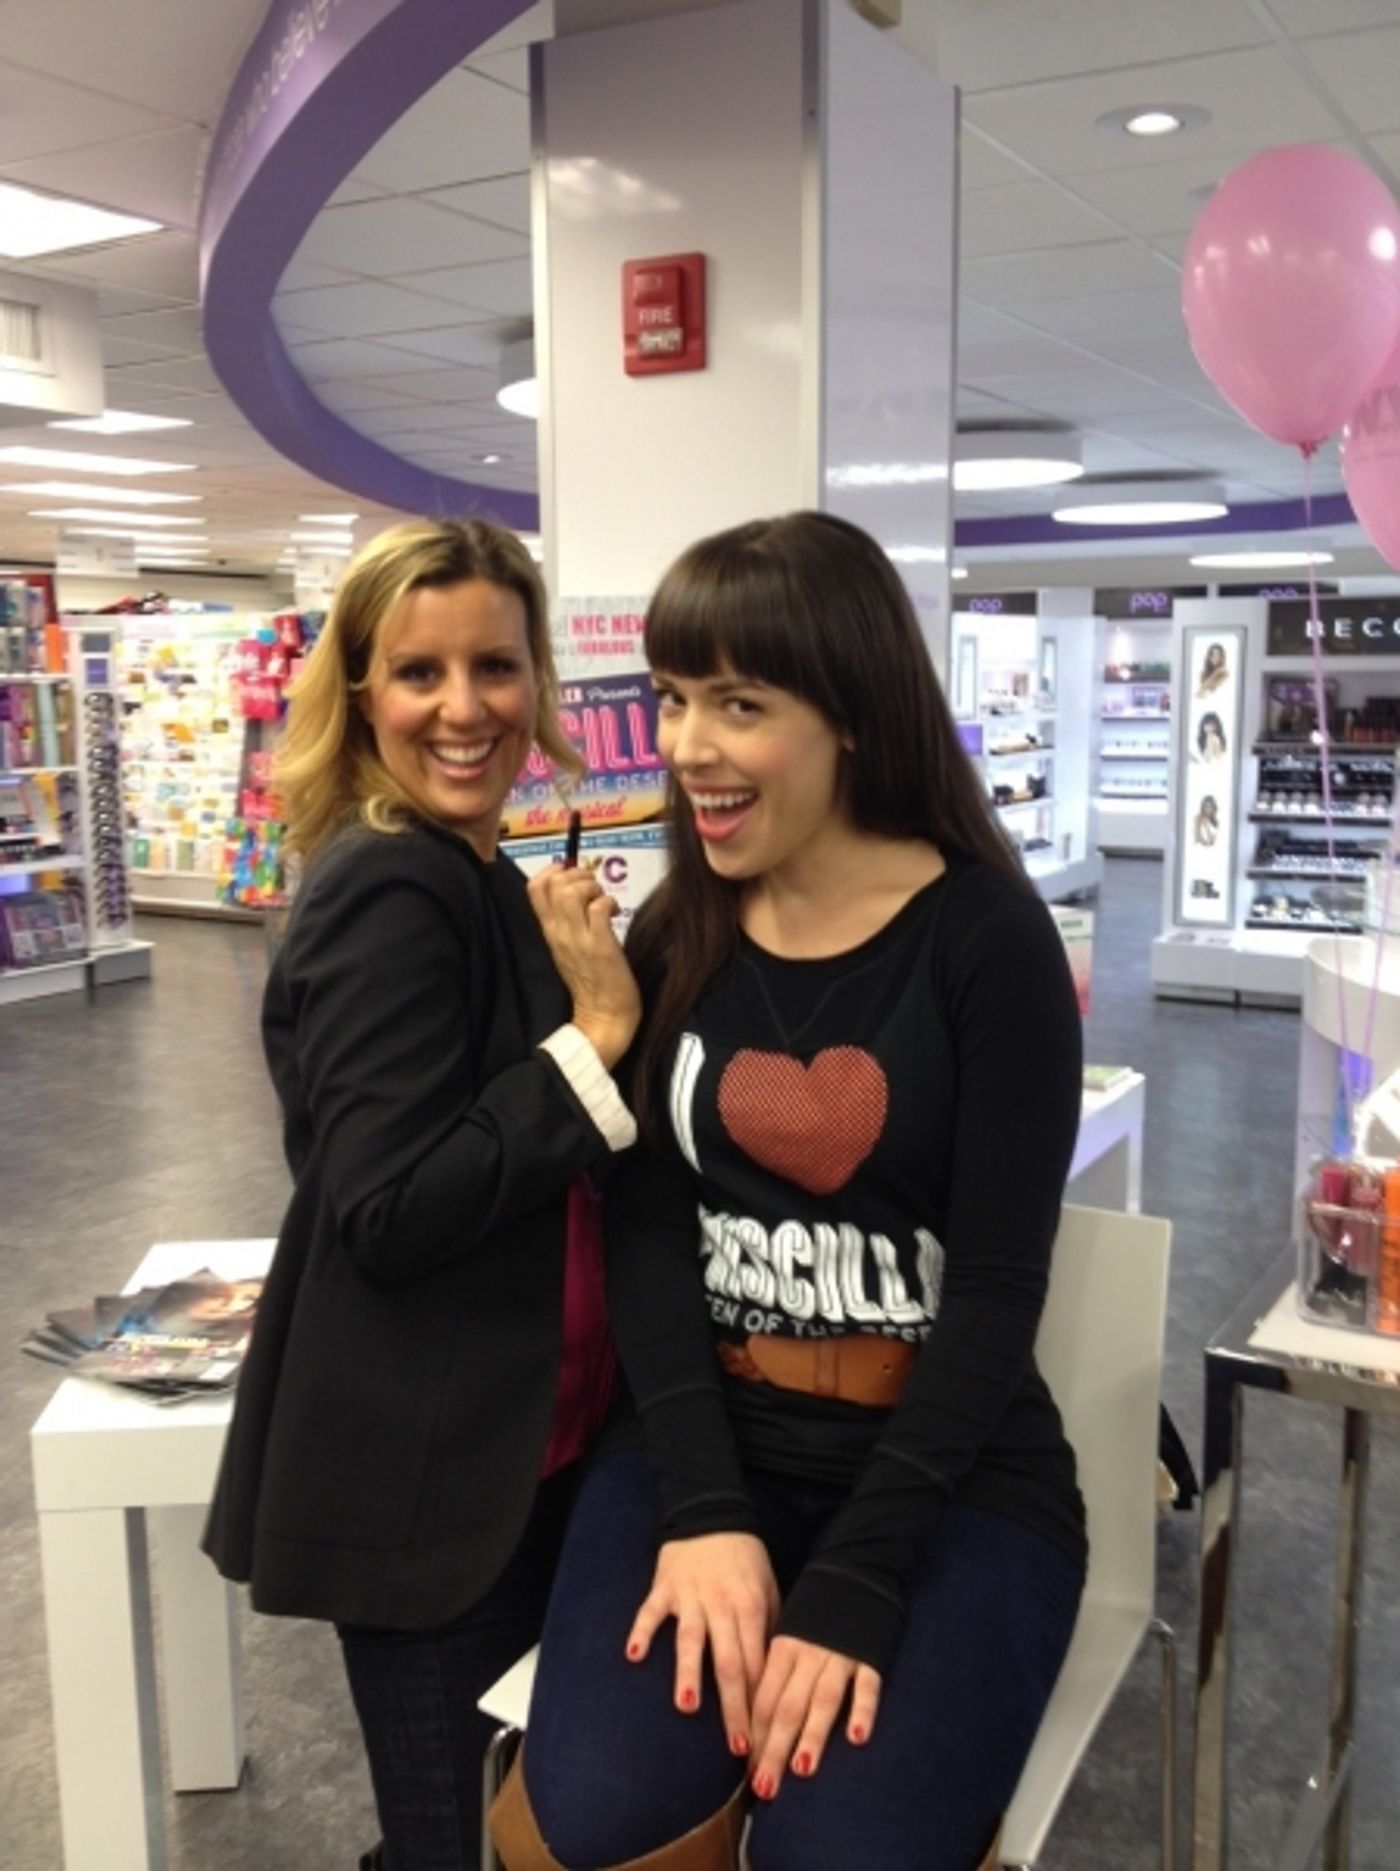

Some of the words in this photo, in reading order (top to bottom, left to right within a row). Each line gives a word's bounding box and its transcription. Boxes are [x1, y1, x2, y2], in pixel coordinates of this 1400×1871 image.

[570, 614, 607, 635] NYC
[669, 1031, 706, 1174] I
[743, 1309, 784, 1333] OF
